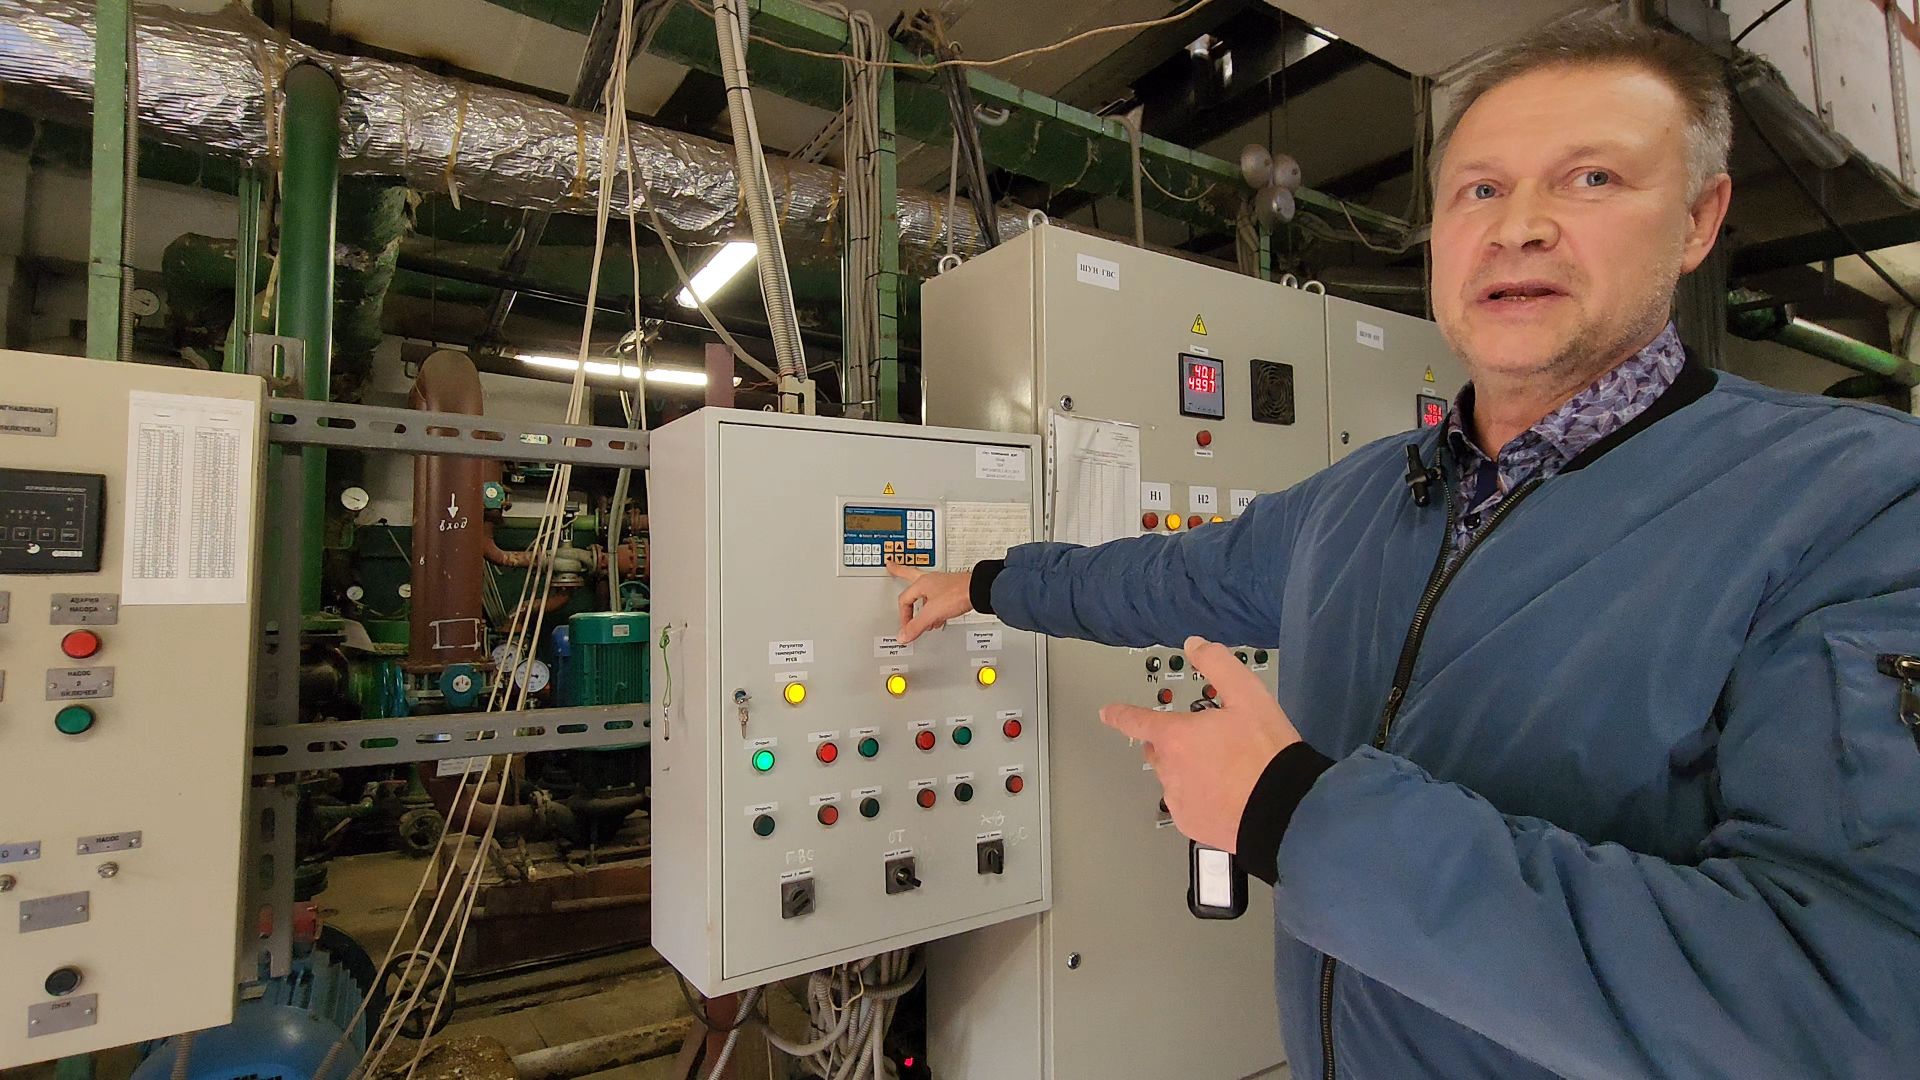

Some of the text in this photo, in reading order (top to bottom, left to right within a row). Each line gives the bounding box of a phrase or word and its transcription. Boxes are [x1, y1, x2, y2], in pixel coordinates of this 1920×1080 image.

[1080, 263, 1115, 278] ШУН ГВС
[1198, 494, 1209, 504] Н2
